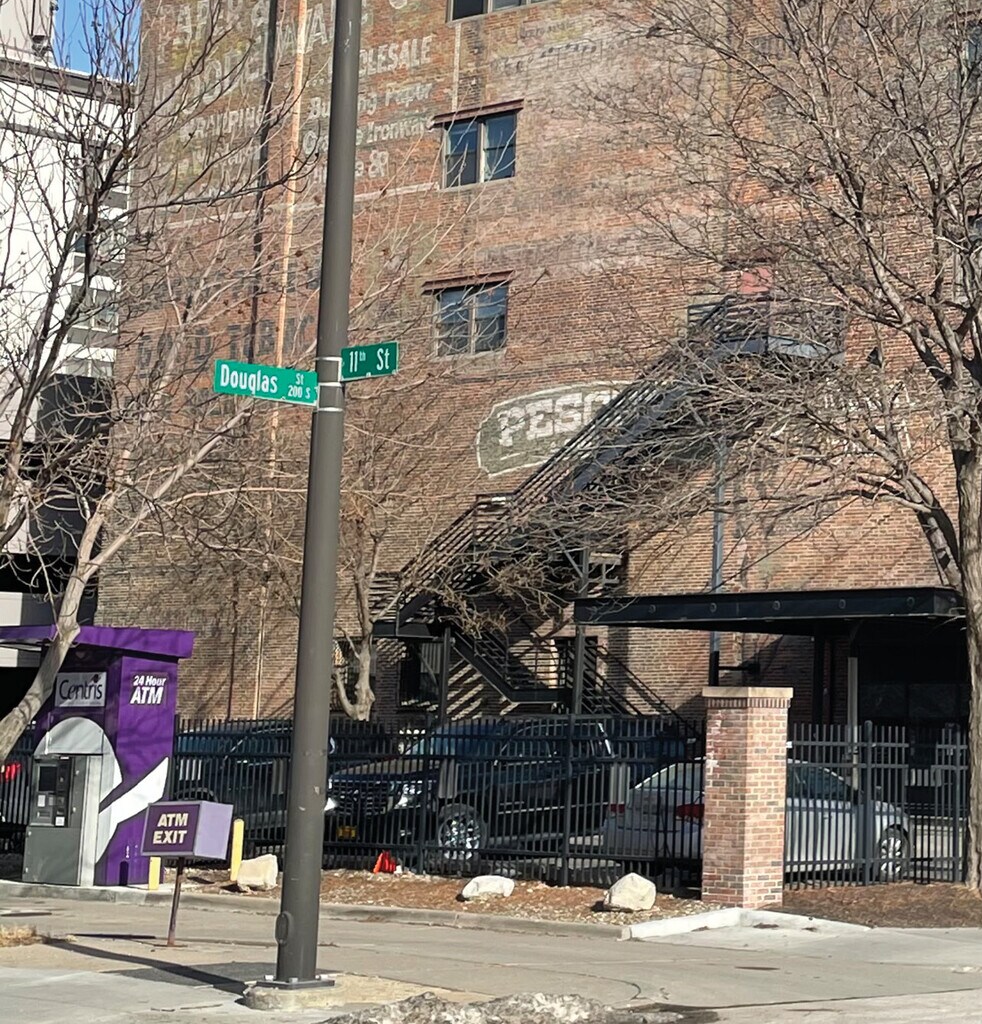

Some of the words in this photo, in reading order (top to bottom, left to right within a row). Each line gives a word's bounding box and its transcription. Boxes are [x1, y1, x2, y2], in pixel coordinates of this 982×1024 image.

[349, 350, 366, 373] 11th
[376, 348, 390, 371] St
[220, 364, 278, 396] Douglas
[295, 373, 305, 385] St
[287, 385, 303, 398] 200
[305, 387, 311, 399] S
[133, 675, 144, 686] 24
[145, 675, 167, 686] Hour
[59, 679, 103, 700] Centris
[129, 686, 164, 704] ATM
[157, 813, 189, 827] ATM
[152, 830, 188, 845] EXIT
